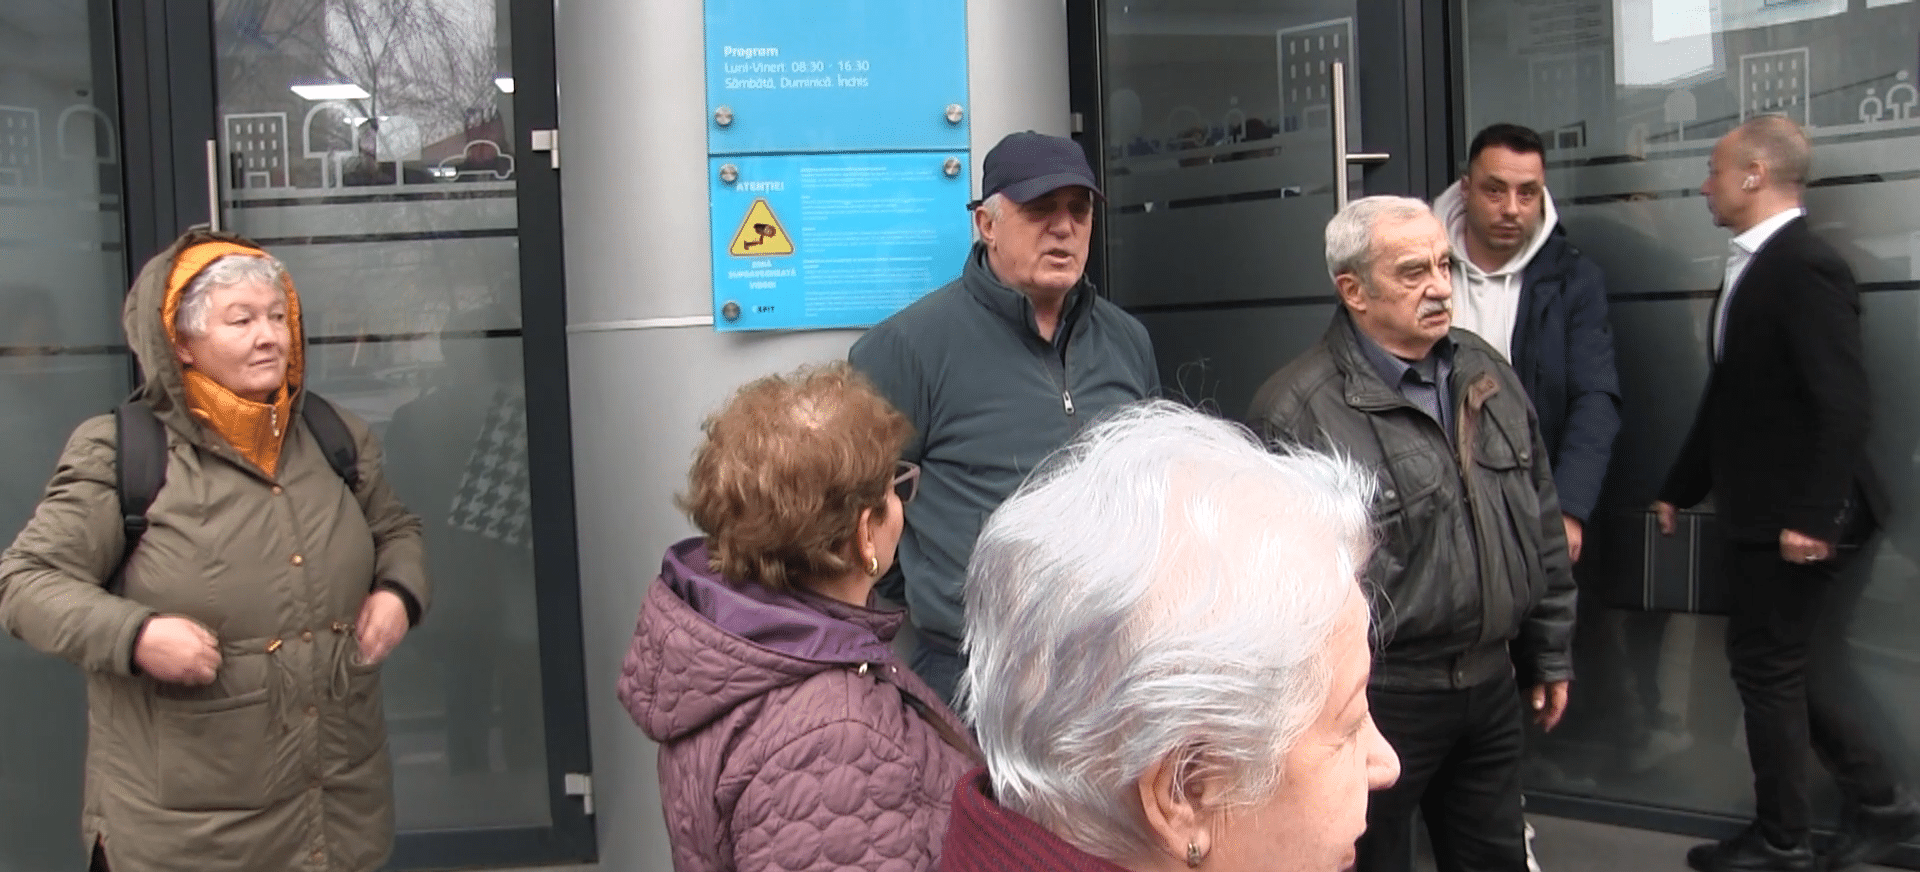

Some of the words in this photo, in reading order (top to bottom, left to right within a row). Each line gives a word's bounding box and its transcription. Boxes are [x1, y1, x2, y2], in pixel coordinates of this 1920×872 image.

[723, 45, 779, 59] Program
[791, 60, 825, 73] 08:30
[838, 60, 870, 72] 16:30
